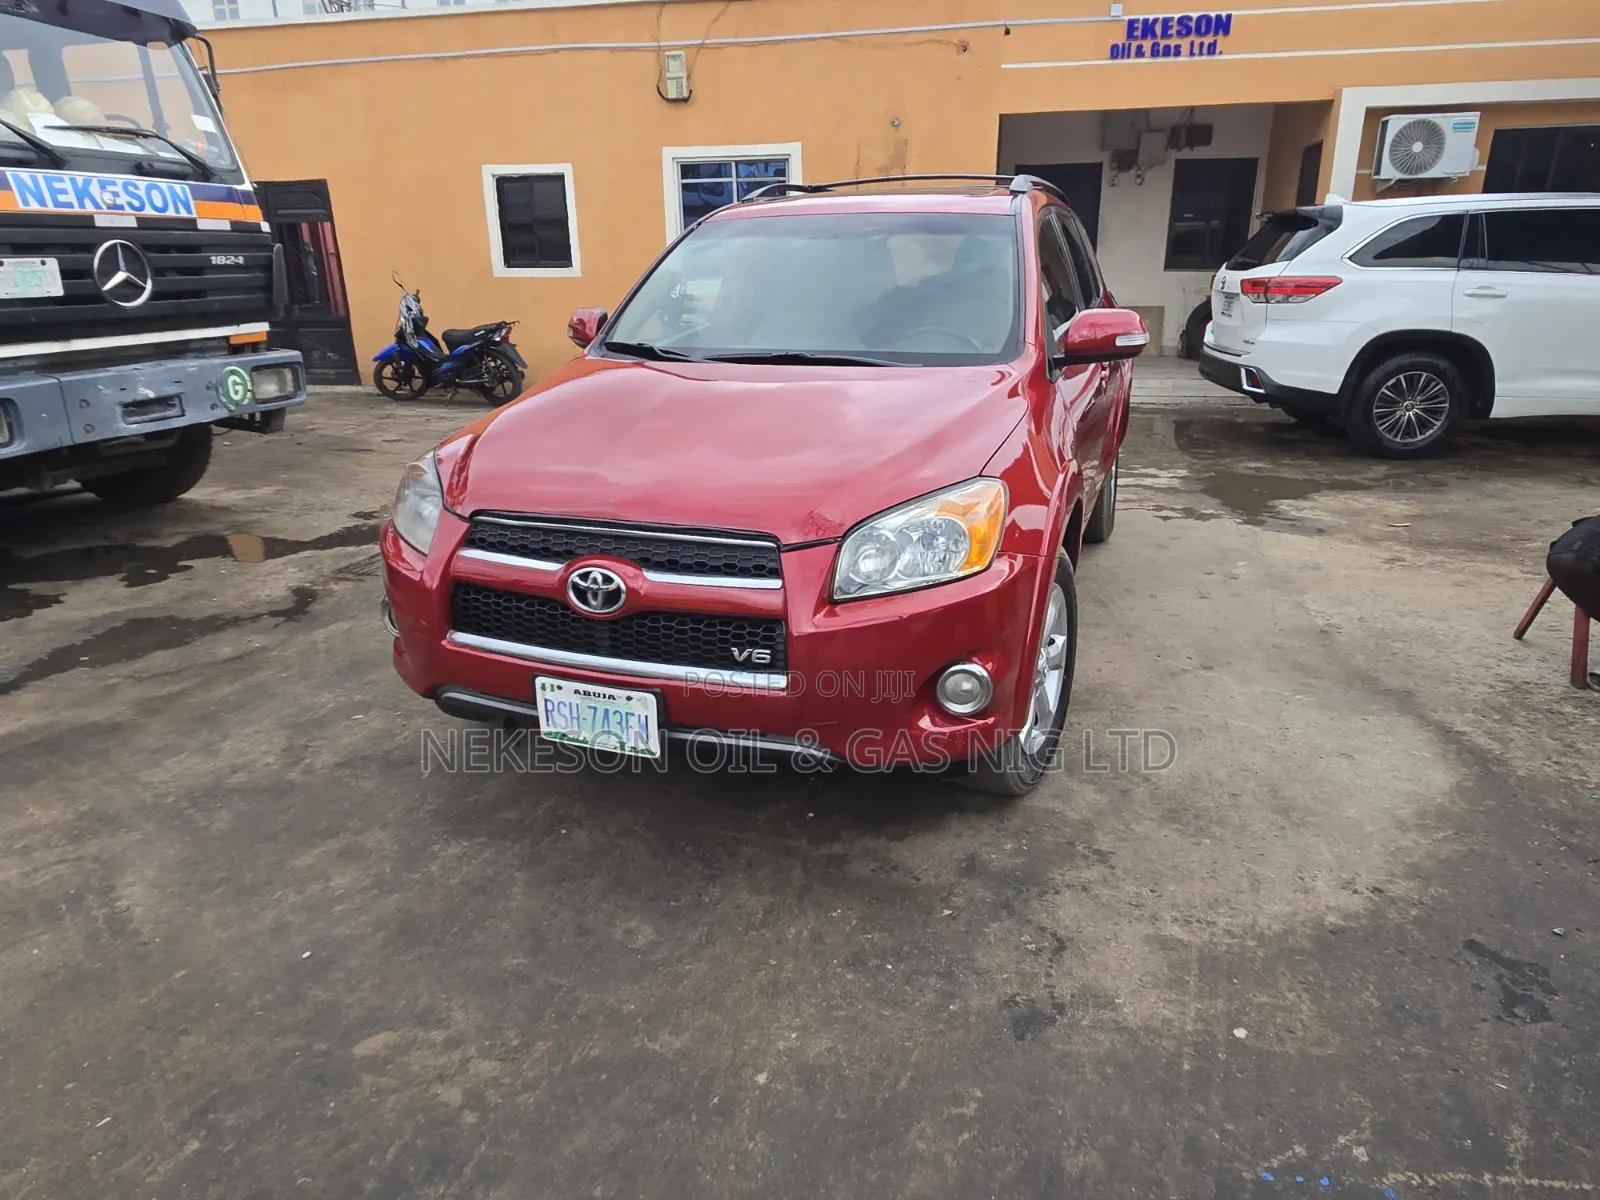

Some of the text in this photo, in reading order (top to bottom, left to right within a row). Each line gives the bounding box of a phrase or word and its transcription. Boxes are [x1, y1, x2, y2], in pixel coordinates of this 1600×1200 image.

[1126, 13, 1232, 41] EKESON
[1110, 39, 1222, 59] Oil & Gas Ltd.
[8, 172, 194, 216] NEKESON
[210, 255, 244, 265] 1824
[731, 647, 771, 663] V6
[573, 688, 617, 701] ABUJA
